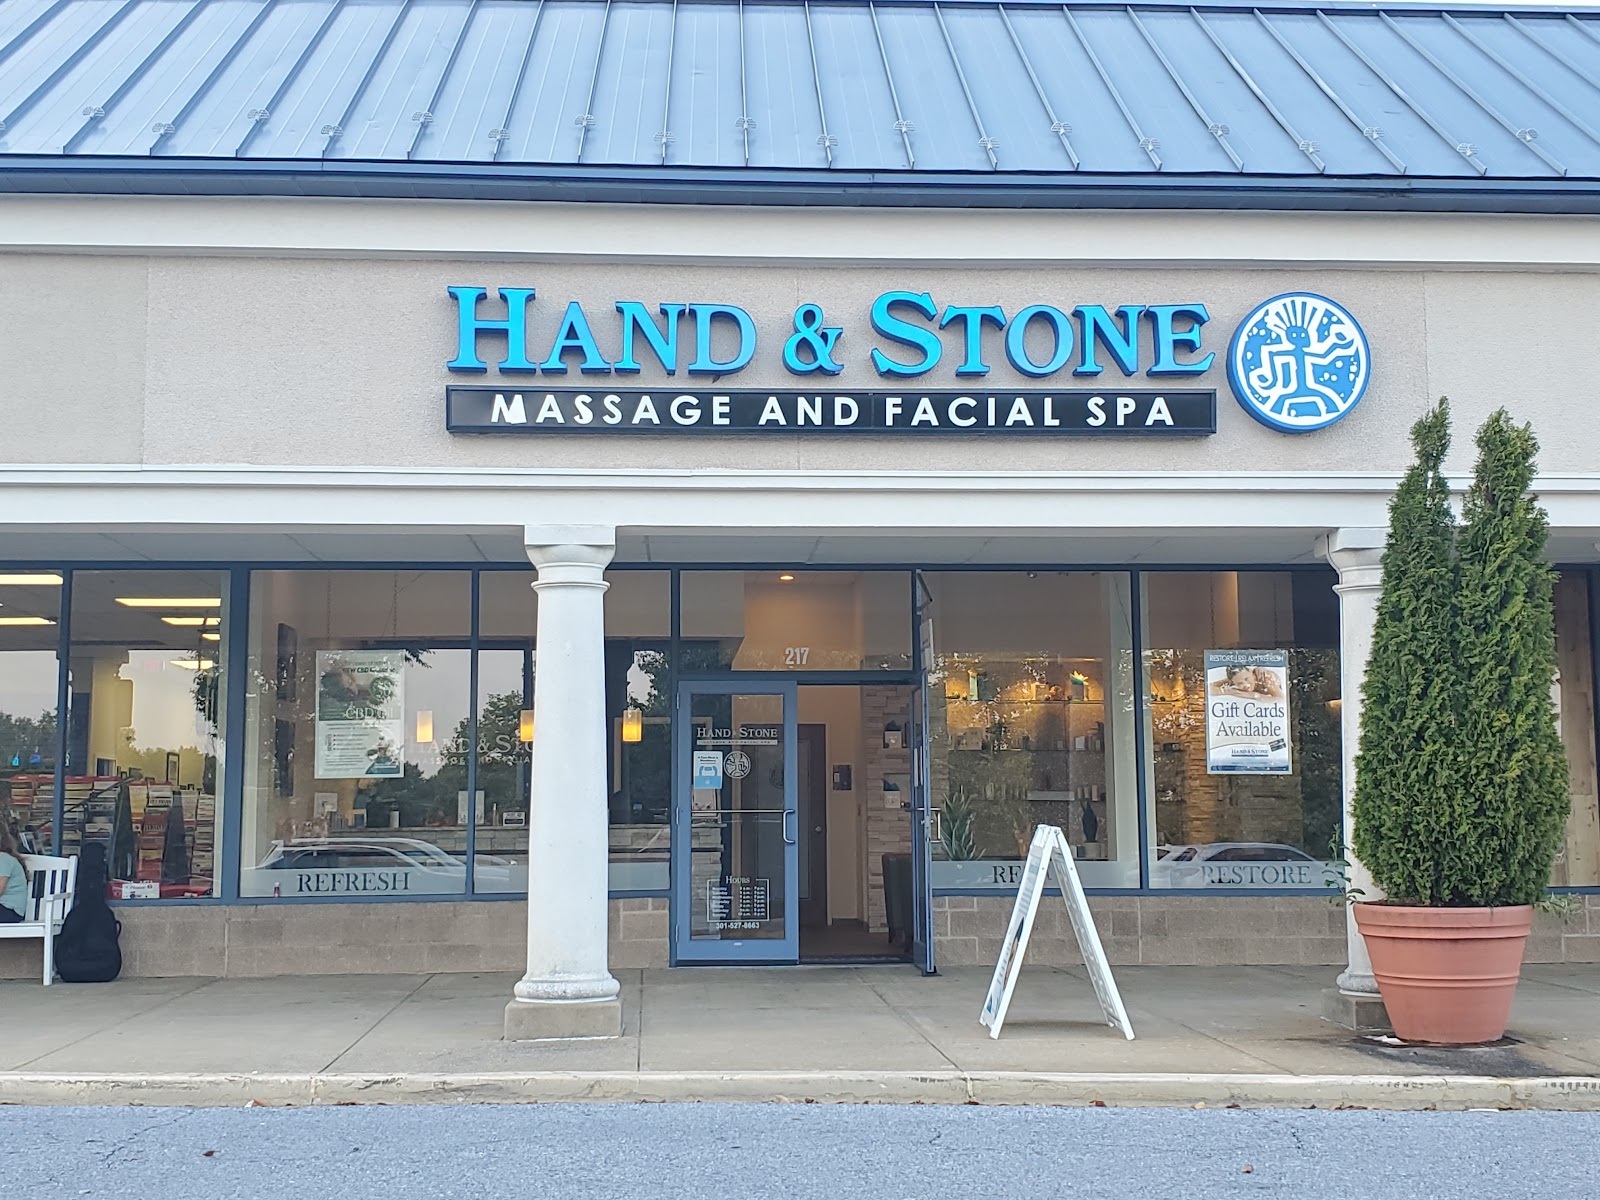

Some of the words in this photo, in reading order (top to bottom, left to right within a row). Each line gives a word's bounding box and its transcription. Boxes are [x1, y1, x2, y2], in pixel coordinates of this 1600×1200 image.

[447, 285, 757, 376] HAND
[782, 303, 844, 376] &
[870, 290, 1216, 378] STONE
[491, 394, 731, 425] MASSAGE
[758, 395, 860, 426] AND
[885, 396, 1060, 427] FACIAL
[1085, 396, 1174, 427] SPA
[785, 644, 810, 665] 217
[1211, 702, 1240, 718] Gift
[1243, 702, 1285, 718] Cards
[696, 727, 731, 738] HAND
[739, 727, 778, 738] STONE
[1216, 721, 1281, 737] Available
[297, 871, 410, 893] REFRESH
[1201, 865, 1312, 885] RESTORE
